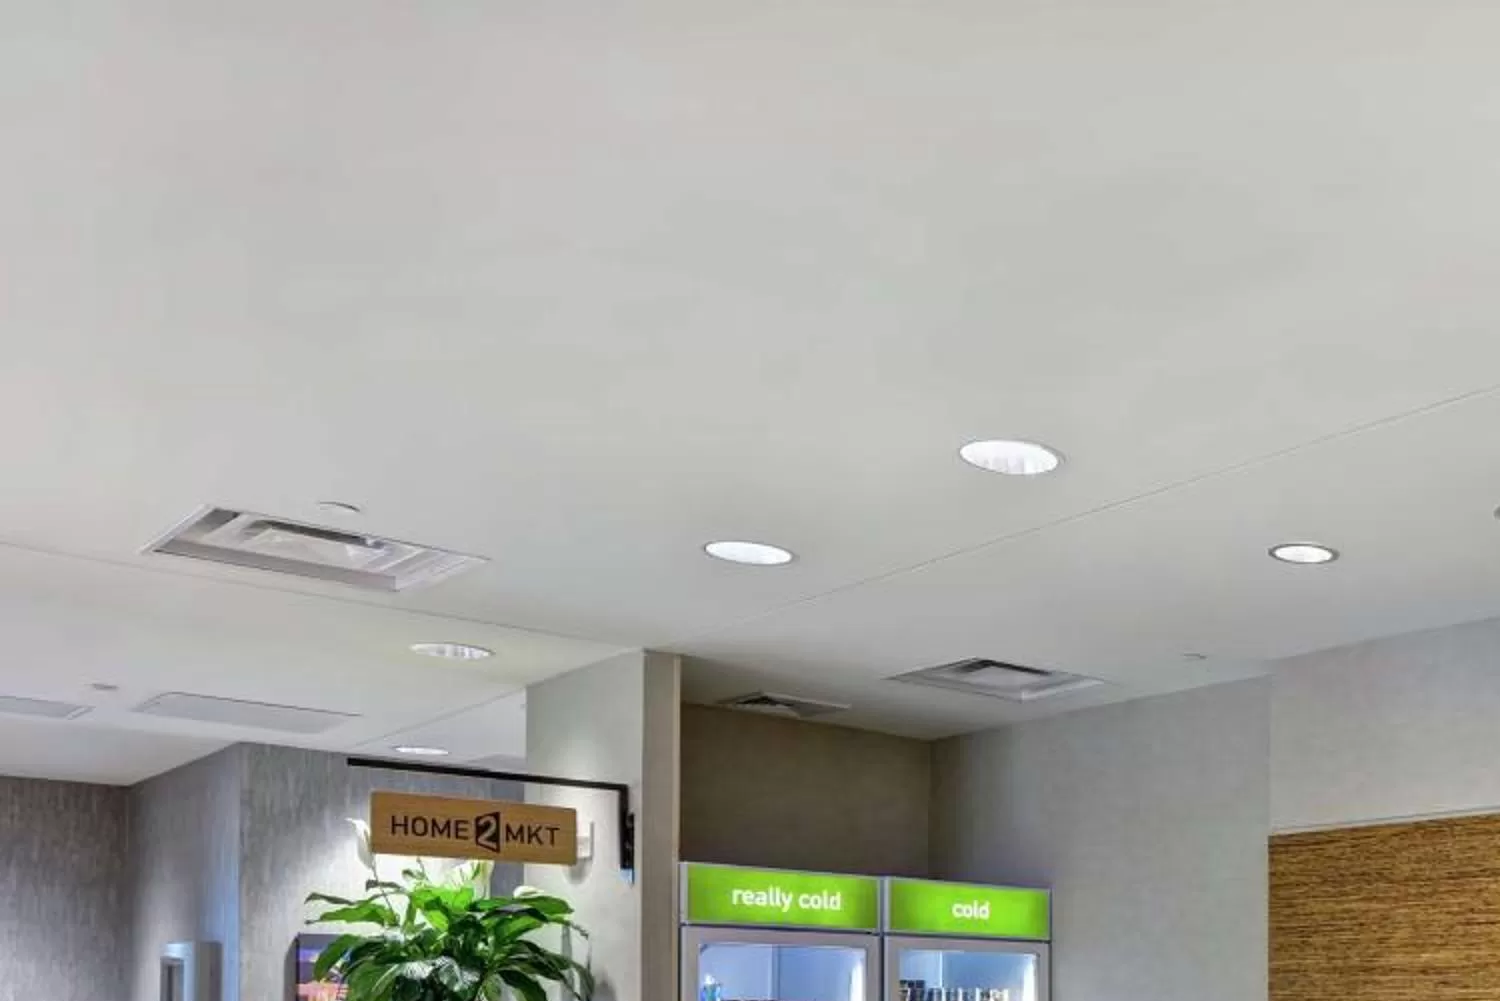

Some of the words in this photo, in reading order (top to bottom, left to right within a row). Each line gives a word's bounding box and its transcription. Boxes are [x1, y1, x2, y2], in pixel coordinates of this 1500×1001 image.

[732, 888, 793, 912] really
[798, 891, 842, 911] cold
[952, 900, 990, 920] cold
